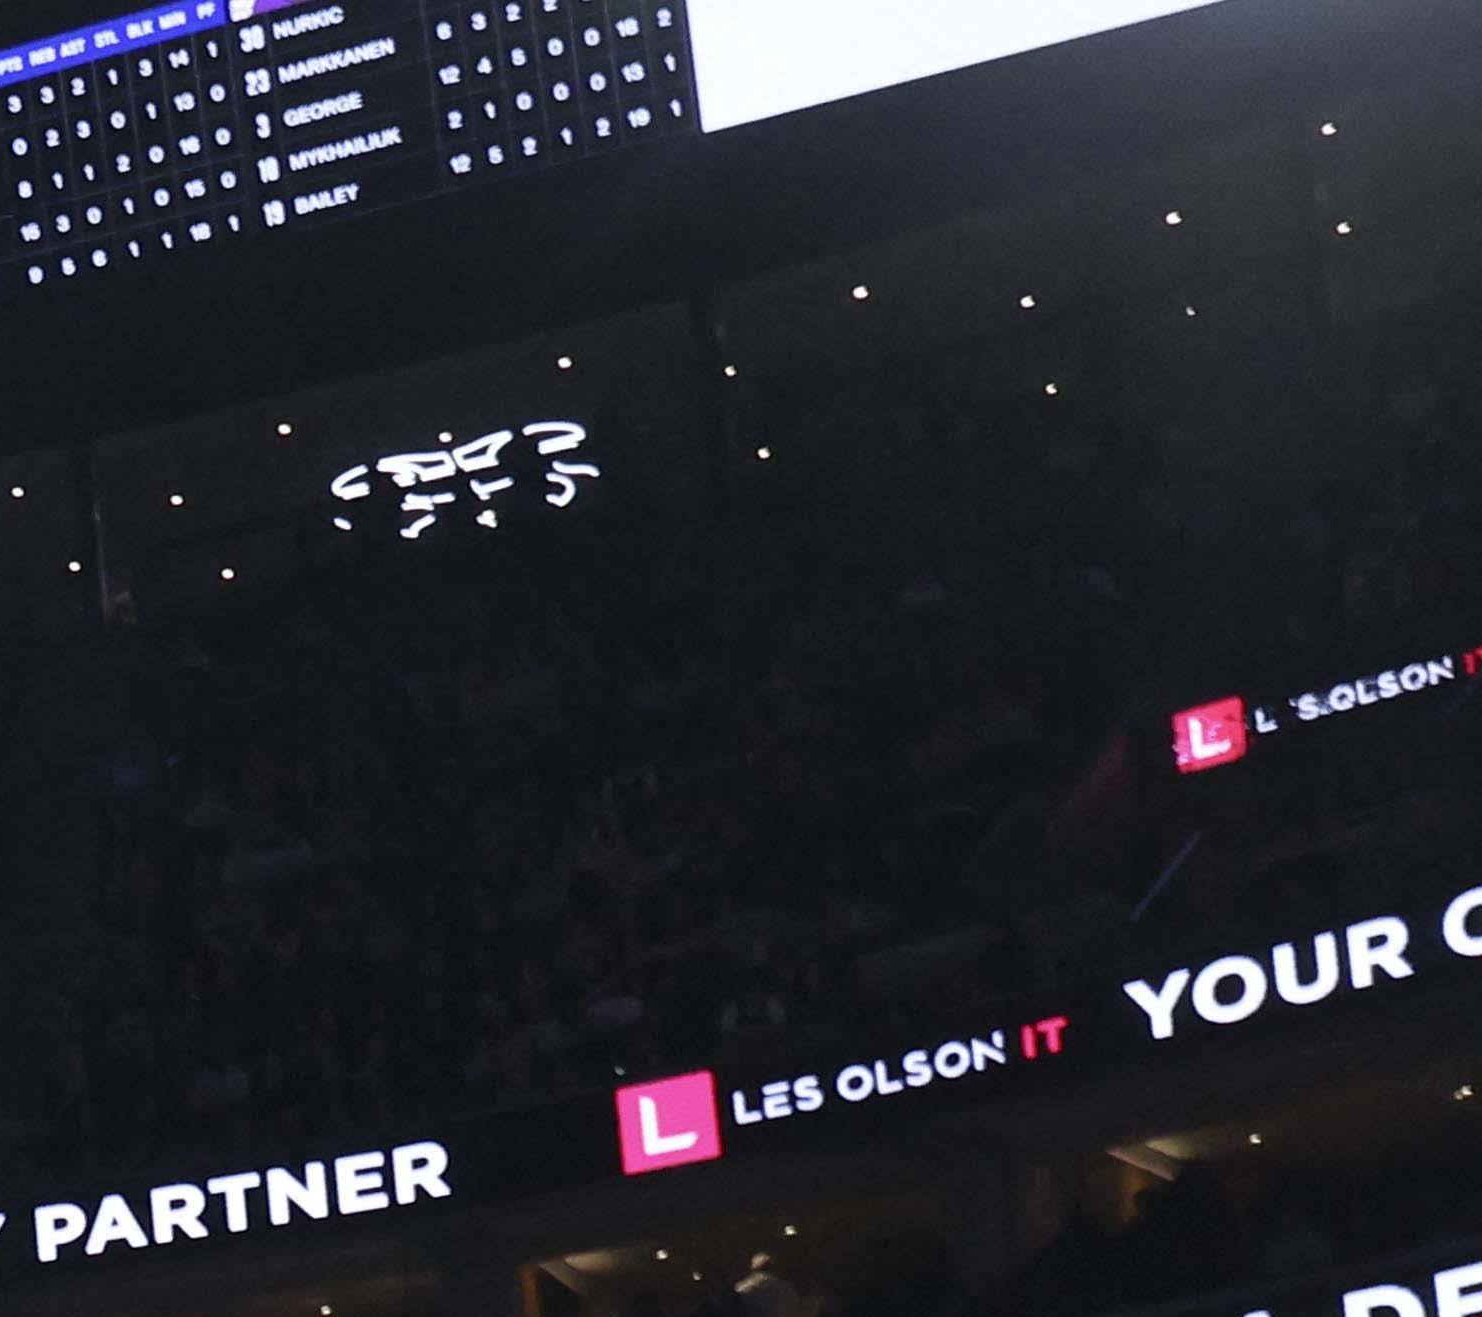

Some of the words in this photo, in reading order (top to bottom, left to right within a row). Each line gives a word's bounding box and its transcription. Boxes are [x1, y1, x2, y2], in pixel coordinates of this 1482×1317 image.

[272, 6, 344, 40] NURKIC
[278, 38, 395, 84] MARKKANEN
[283, 92, 363, 127] GEORGE
[294, 183, 359, 215] BAILEY
[639, 1096, 698, 1156] L
[732, 1075, 824, 1125] LES
[836, 1030, 1006, 1101] OLSON
[1021, 1016, 1068, 1059] IT
[1123, 917, 1414, 1039] YOUR
[34, 1141, 451, 1262] PARTNER
